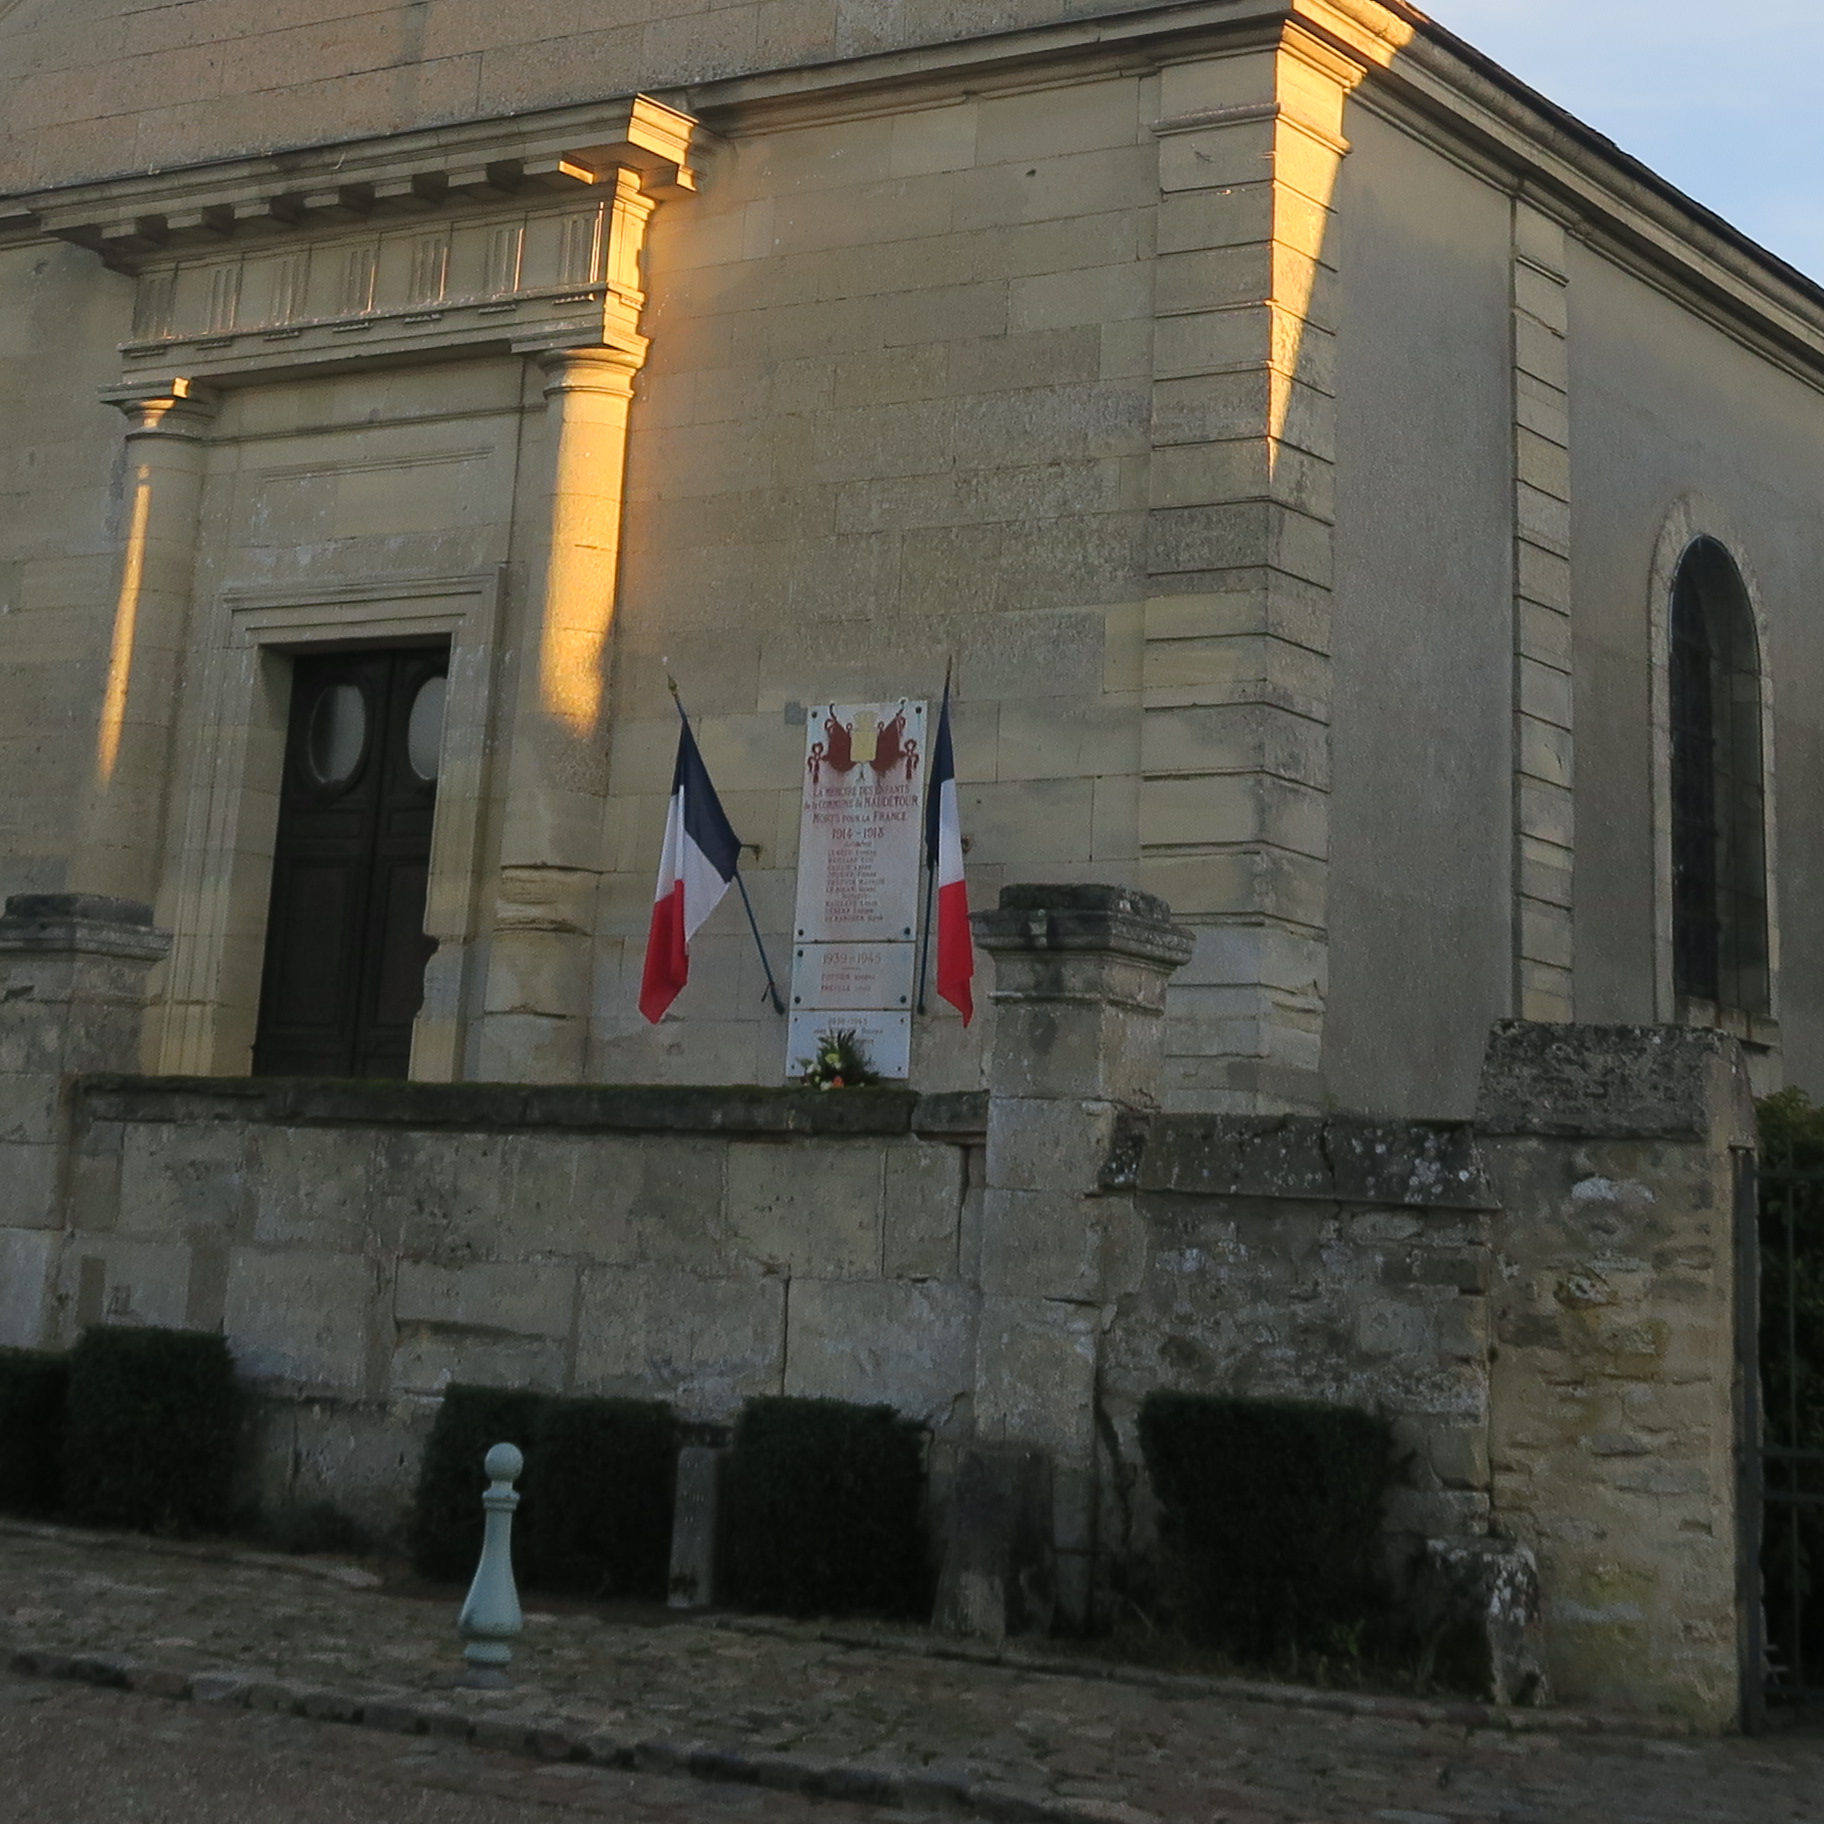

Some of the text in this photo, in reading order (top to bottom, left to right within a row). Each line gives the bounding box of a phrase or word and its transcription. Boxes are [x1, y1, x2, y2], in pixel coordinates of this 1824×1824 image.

[874, 784, 910, 795] ENFANTS
[813, 813, 840, 824] MORTS
[873, 810, 907, 822] FRANCE
